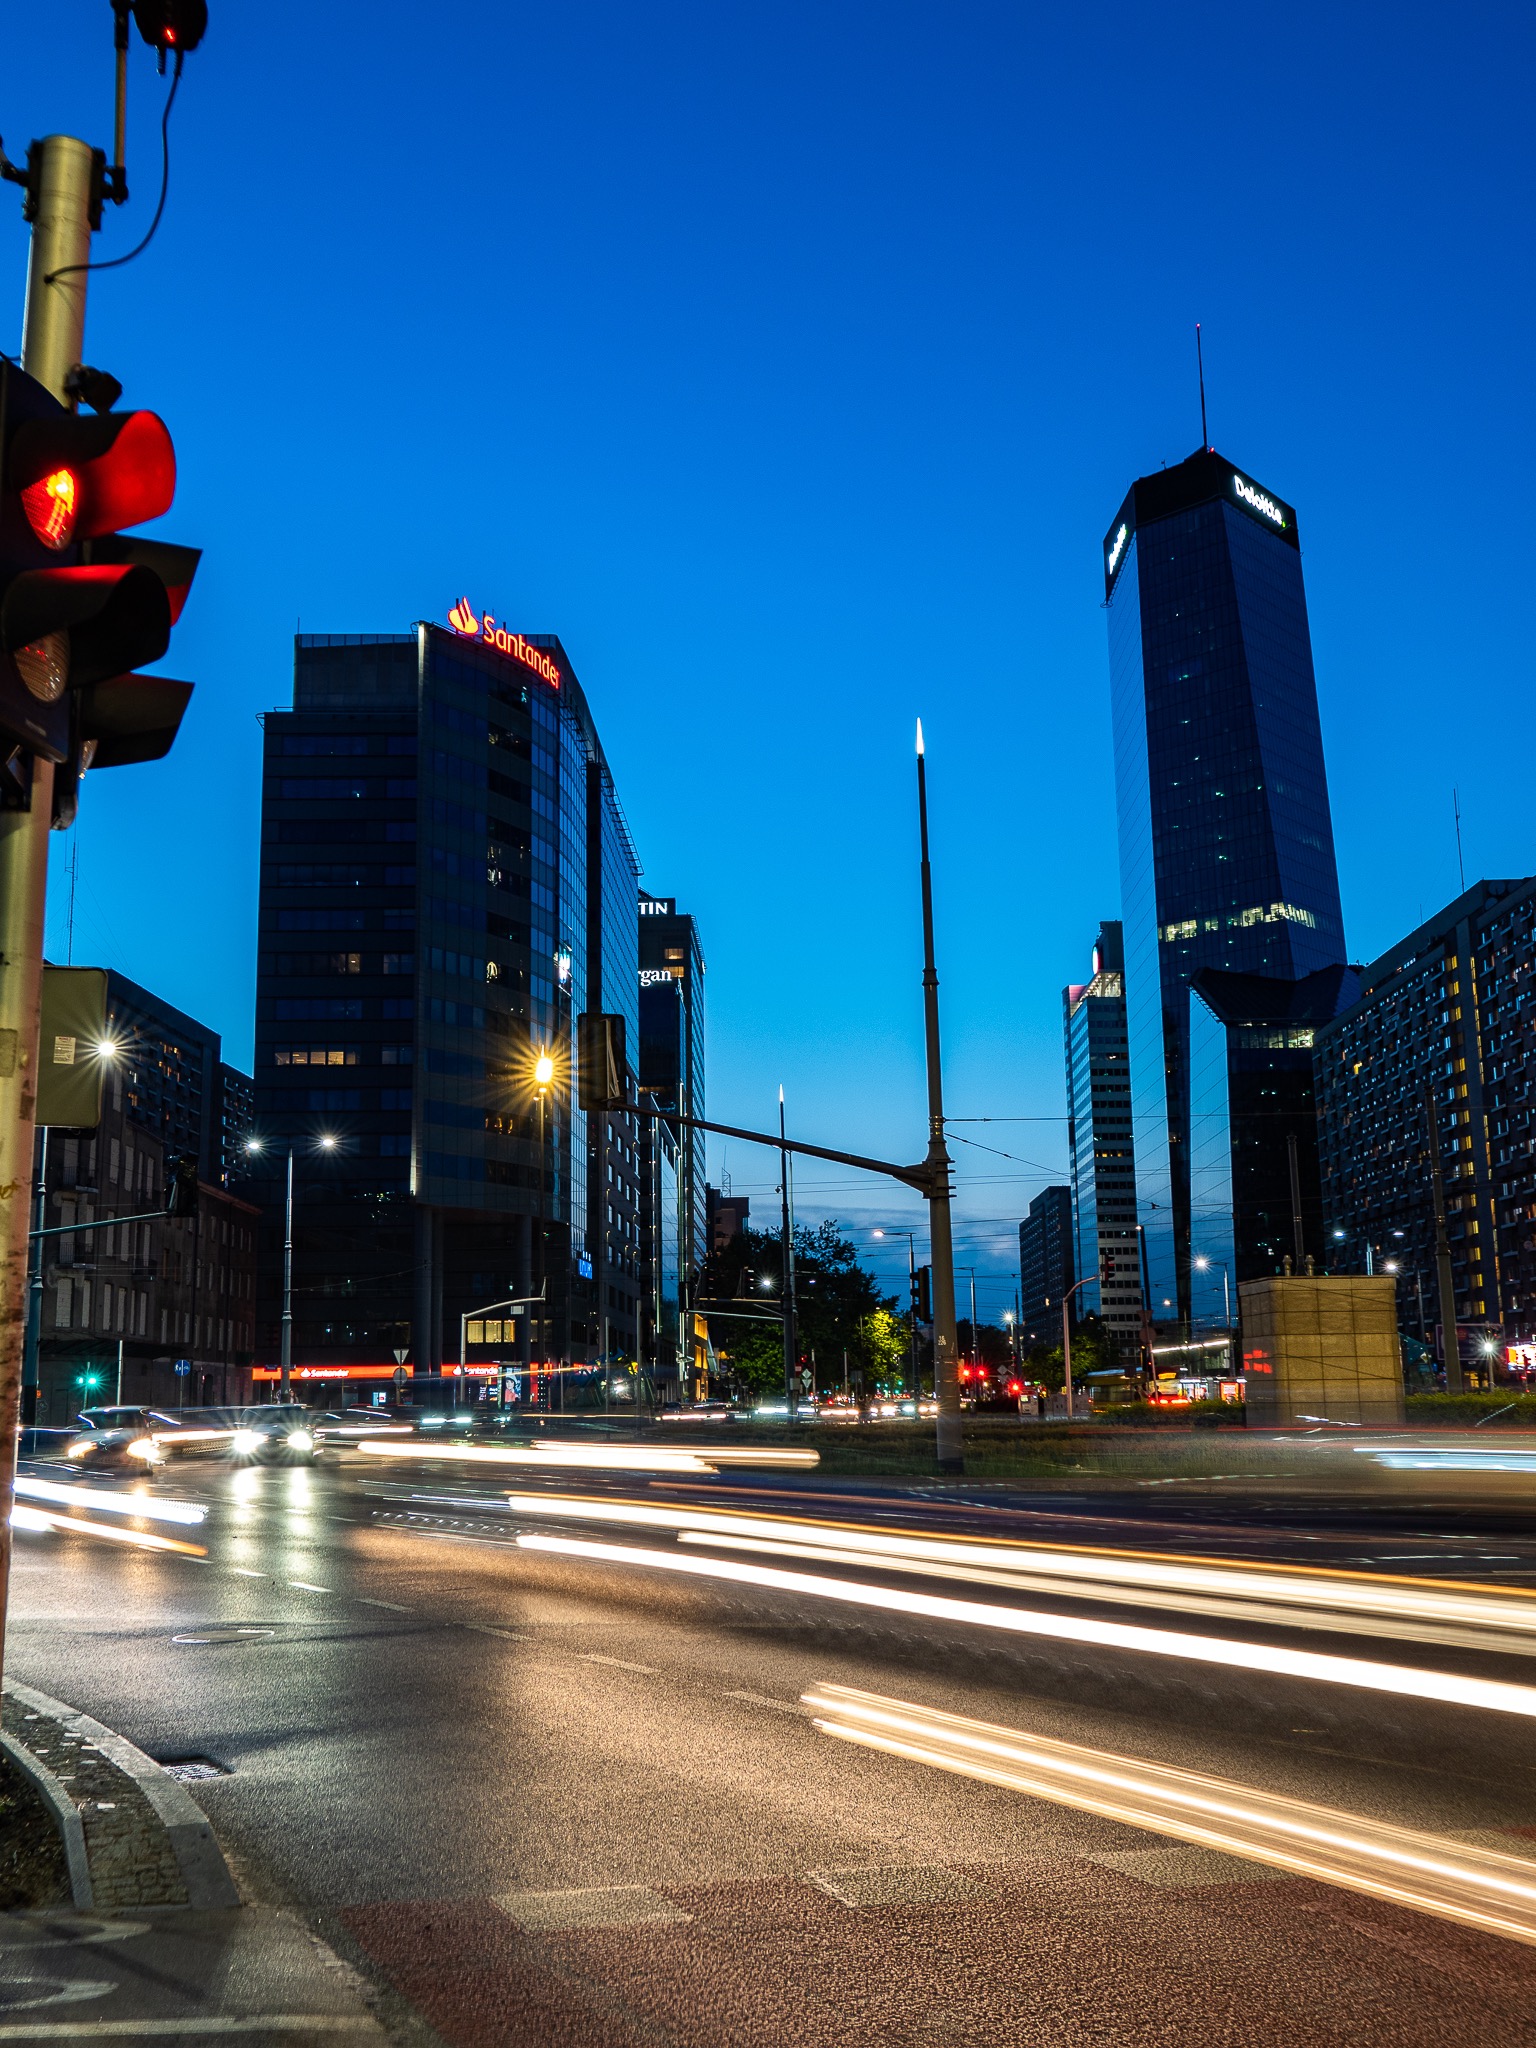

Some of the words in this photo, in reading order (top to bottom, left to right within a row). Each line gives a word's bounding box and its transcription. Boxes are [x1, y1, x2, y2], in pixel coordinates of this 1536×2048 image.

[483, 615, 560, 690] Santander
[637, 901, 668, 915] TIN
[637, 969, 672, 987] gan
